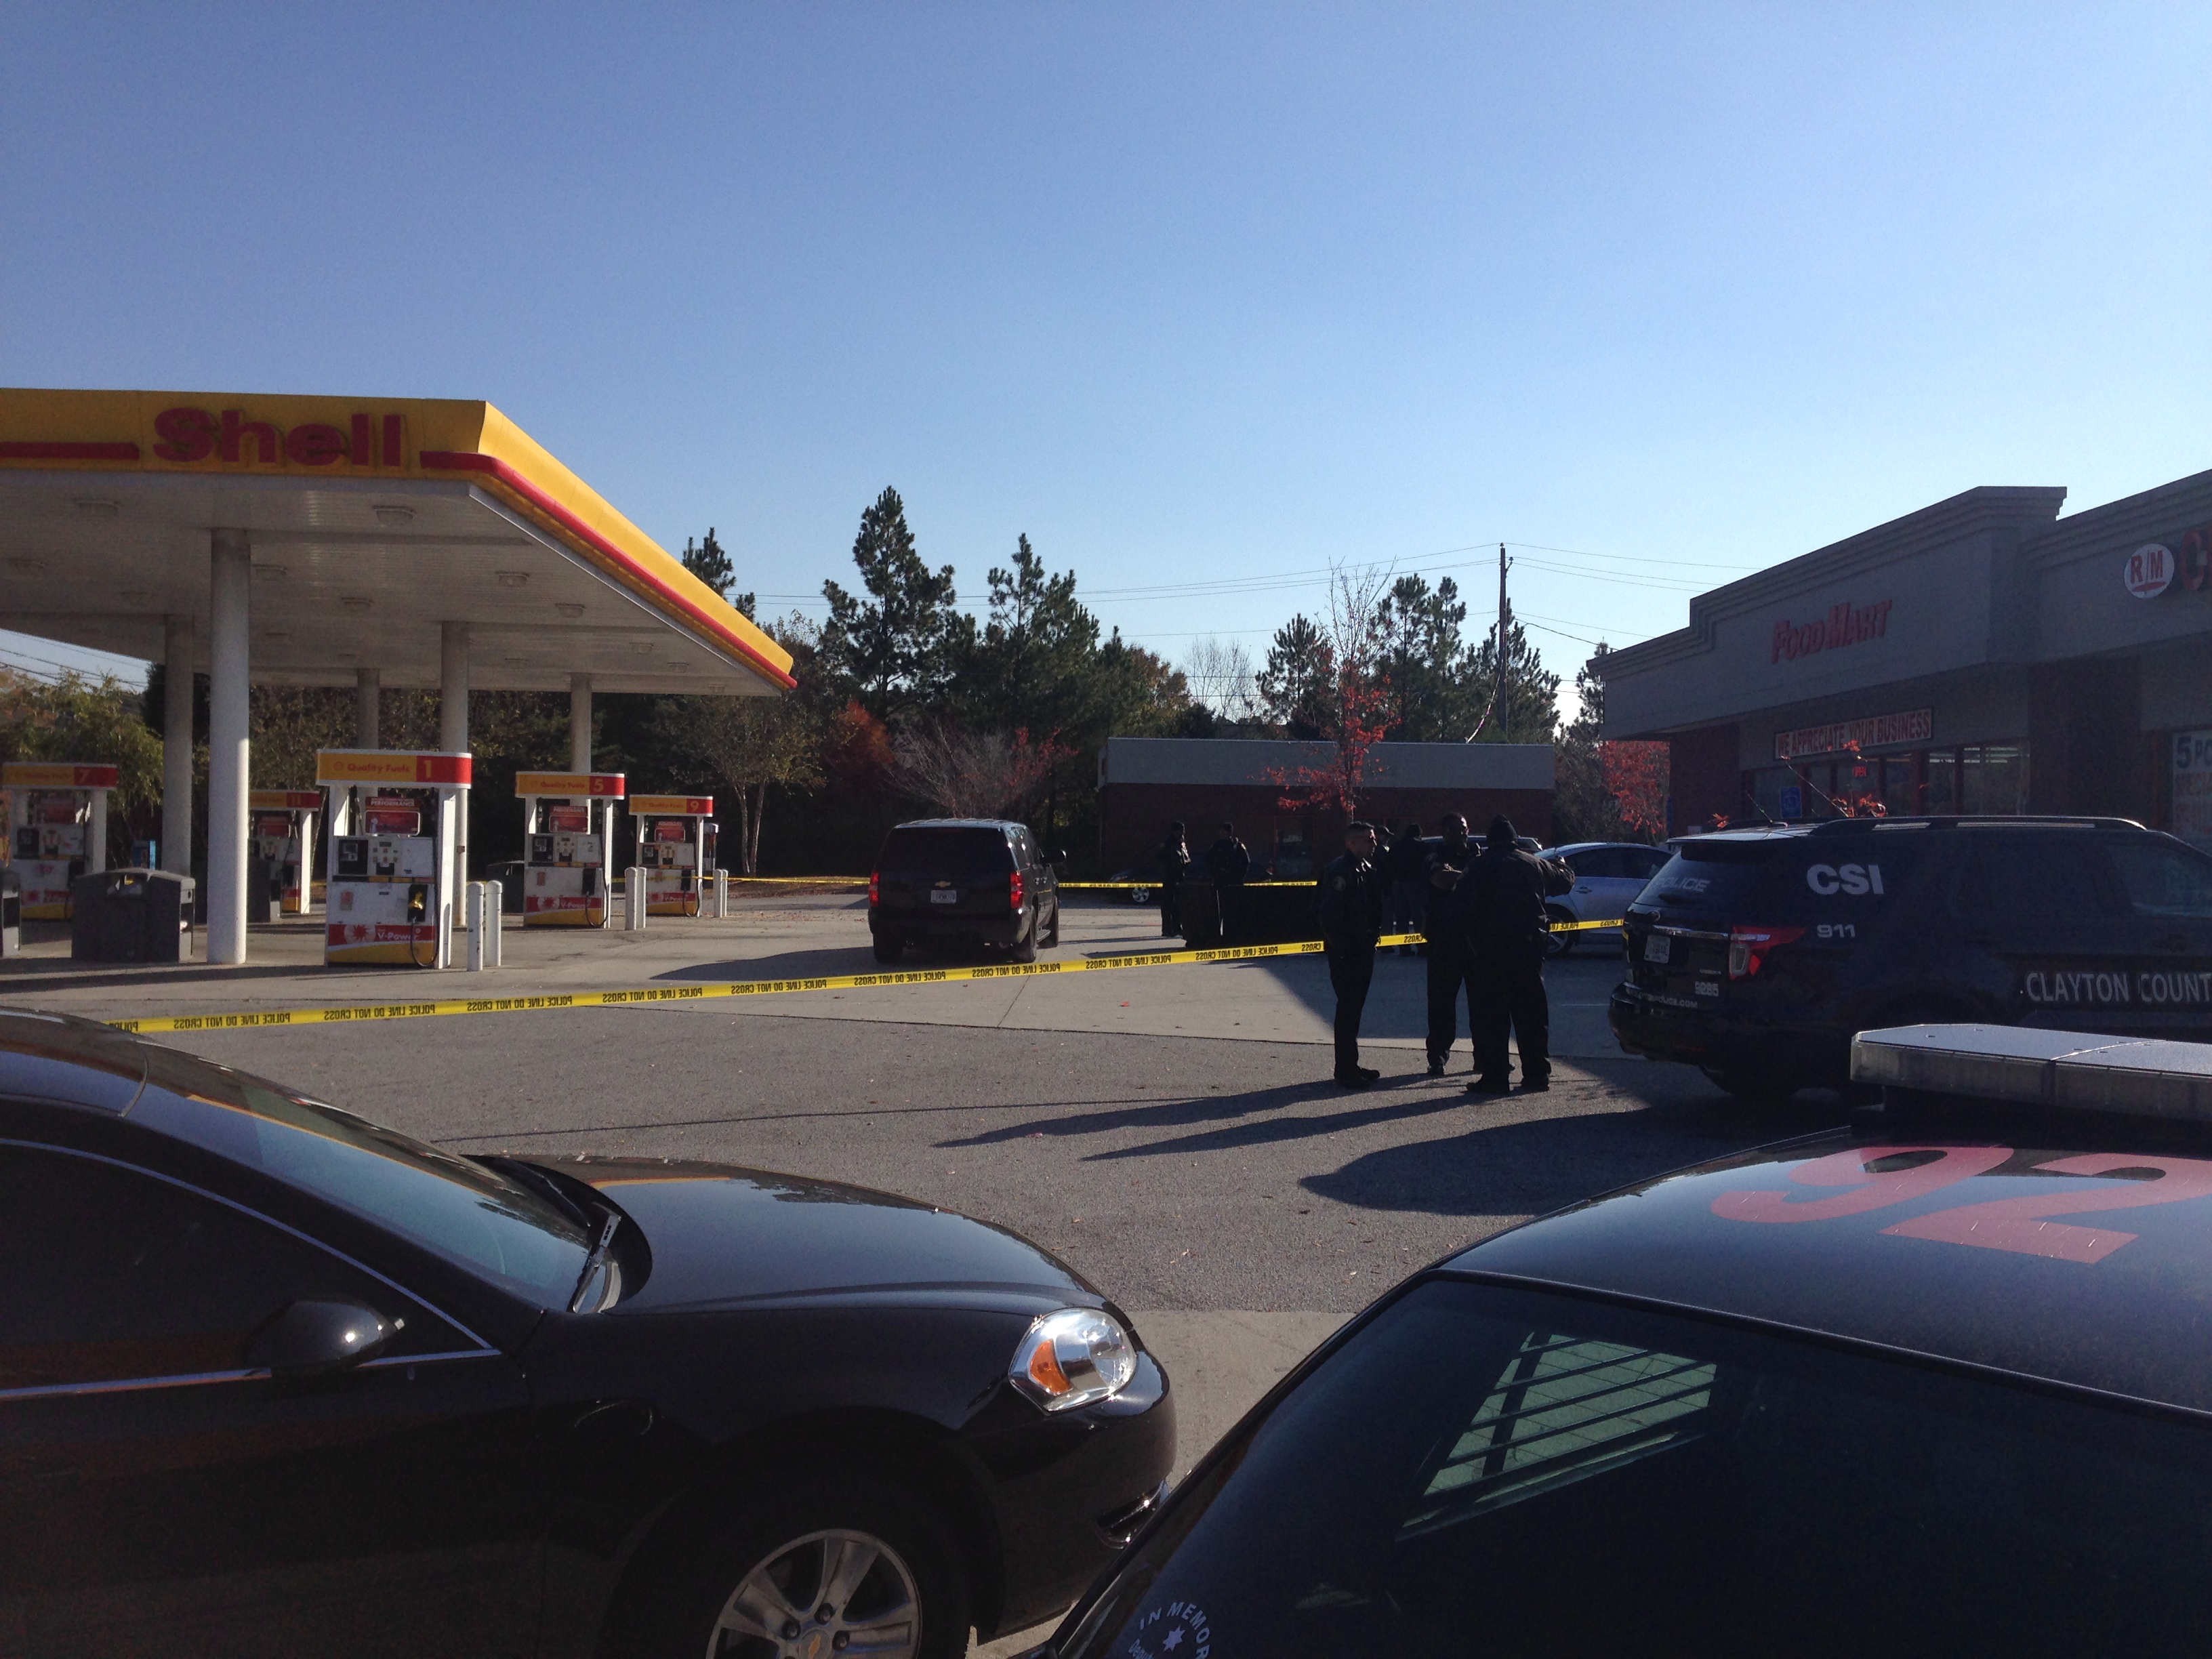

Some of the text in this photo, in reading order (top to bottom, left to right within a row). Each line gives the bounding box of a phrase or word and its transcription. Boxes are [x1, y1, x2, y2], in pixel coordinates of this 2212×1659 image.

[153, 407, 401, 467] Shell
[1778, 711, 1930, 756] WE APPRECIATE YOUR BUSINESS
[2177, 736, 2192, 769] 5
[79, 769, 91, 783] 7
[347, 763, 410, 773] Quality Fuels
[424, 760, 432, 779] 1
[593, 779, 604, 792] 5
[690, 800, 699, 812] 9
[1658, 877, 1712, 893] POLICE
[1807, 863, 1884, 895] CSI
[1817, 924, 1856, 938] 911
[2026, 972, 2130, 1002] CLAYTON
[1710, 1147, 2212, 1265] 92
[1140, 1607, 1162, 1631] IN
